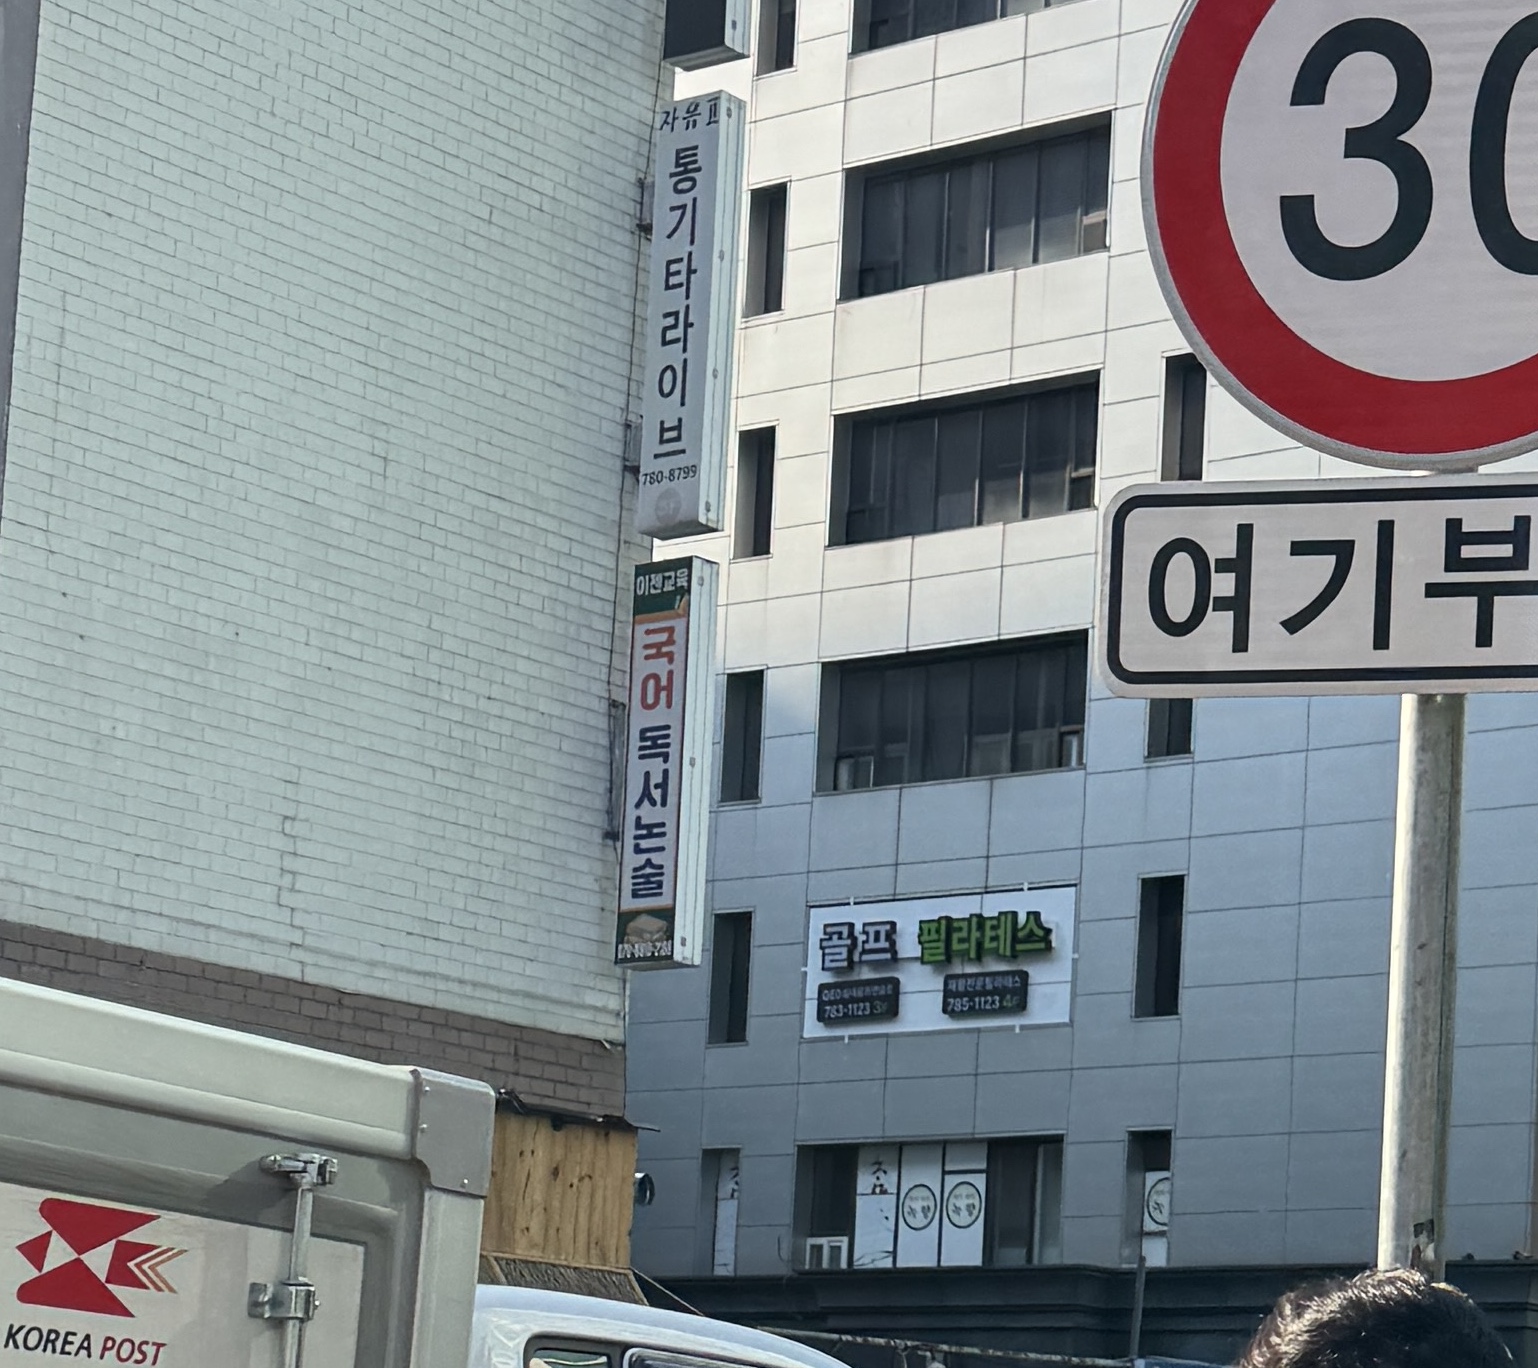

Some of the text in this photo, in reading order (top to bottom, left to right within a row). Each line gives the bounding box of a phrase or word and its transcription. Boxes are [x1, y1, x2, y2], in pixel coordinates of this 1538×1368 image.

[654, 145, 701, 459] 통기타라이브
[642, 464, 697, 485] 780-8799
[636, 569, 689, 596] 이젠교육
[640, 627, 676, 711] 국어
[631, 725, 672, 899] 독서논술
[820, 911, 1055, 972] 골프 필라테스
[4, 1324, 168, 1367] KOREA POST
